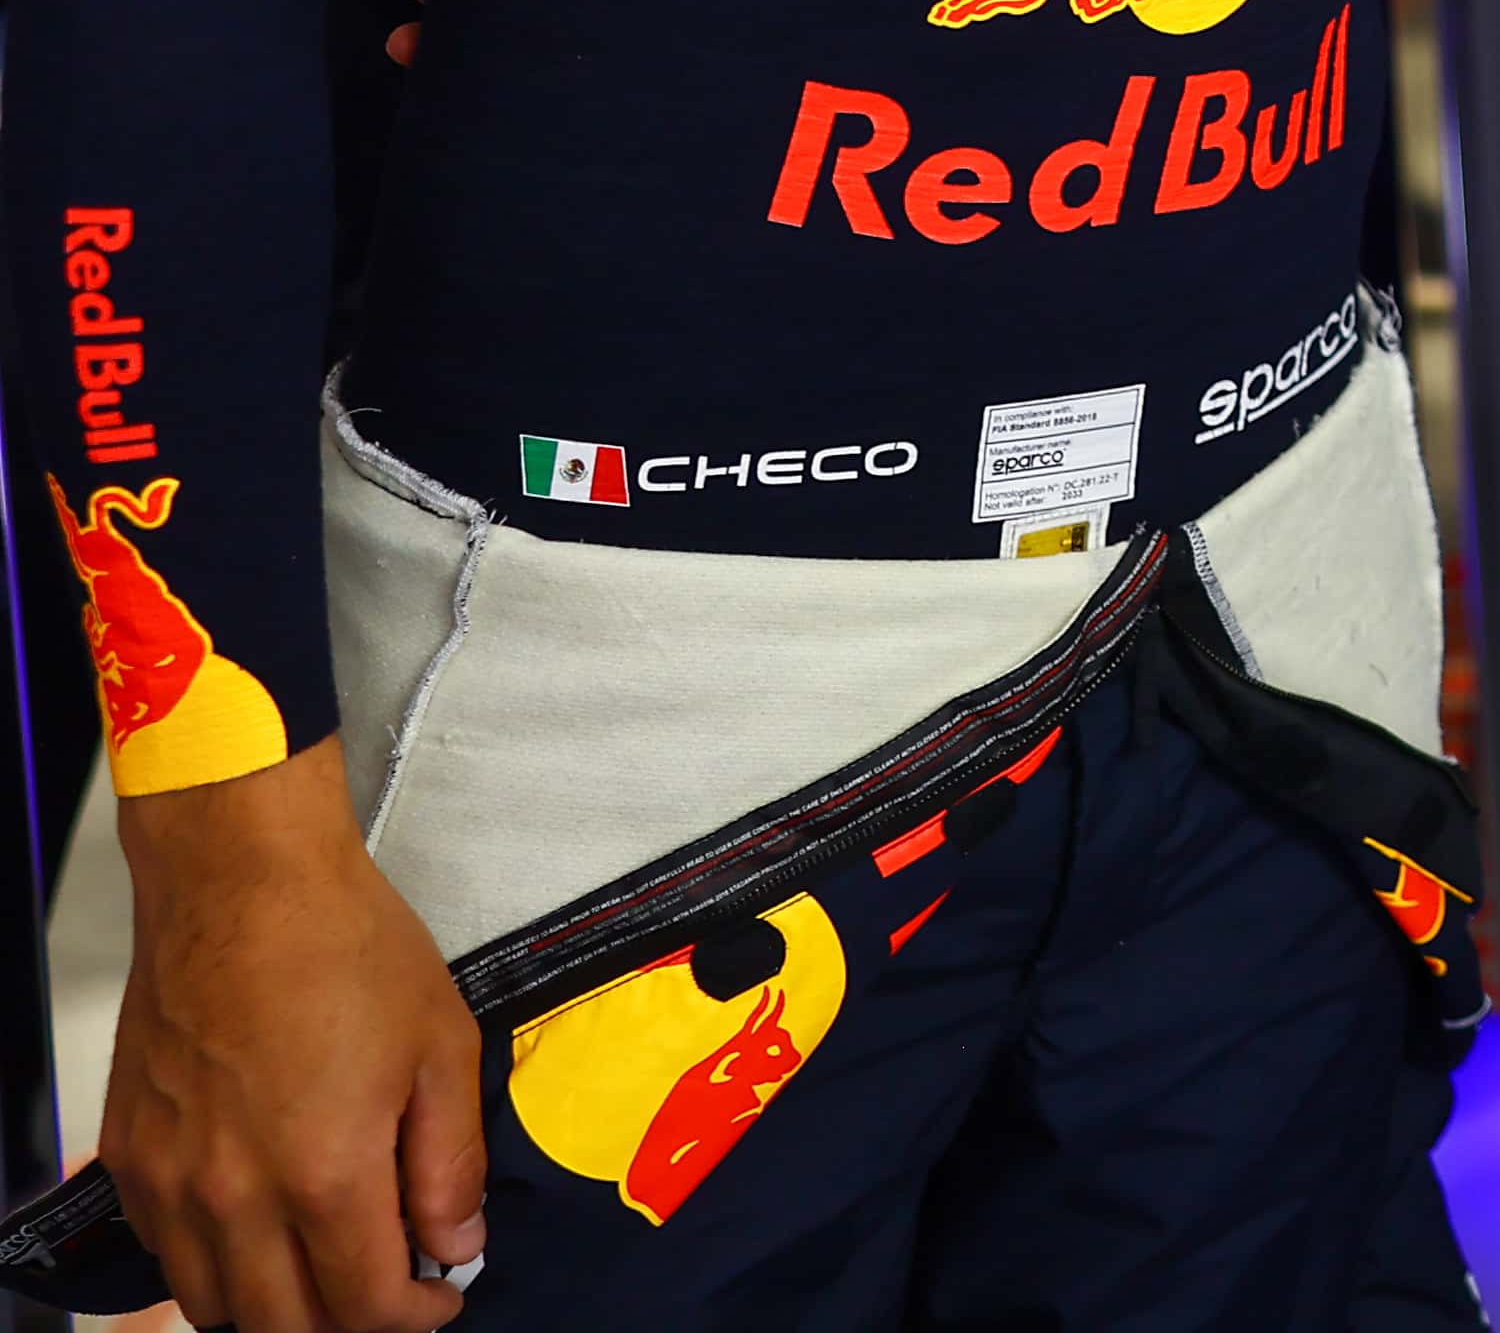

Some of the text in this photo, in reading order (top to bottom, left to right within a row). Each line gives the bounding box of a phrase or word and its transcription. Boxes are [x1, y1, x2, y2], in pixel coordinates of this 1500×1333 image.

[767, 3, 1351, 244] Red Bull
[63, 206, 158, 464] Red Bull
[1199, 292, 1358, 432] sparco
[638, 442, 917, 491] CHECO
[992, 449, 1064, 475] sparco
[1009, 419, 1051, 432] Standard
